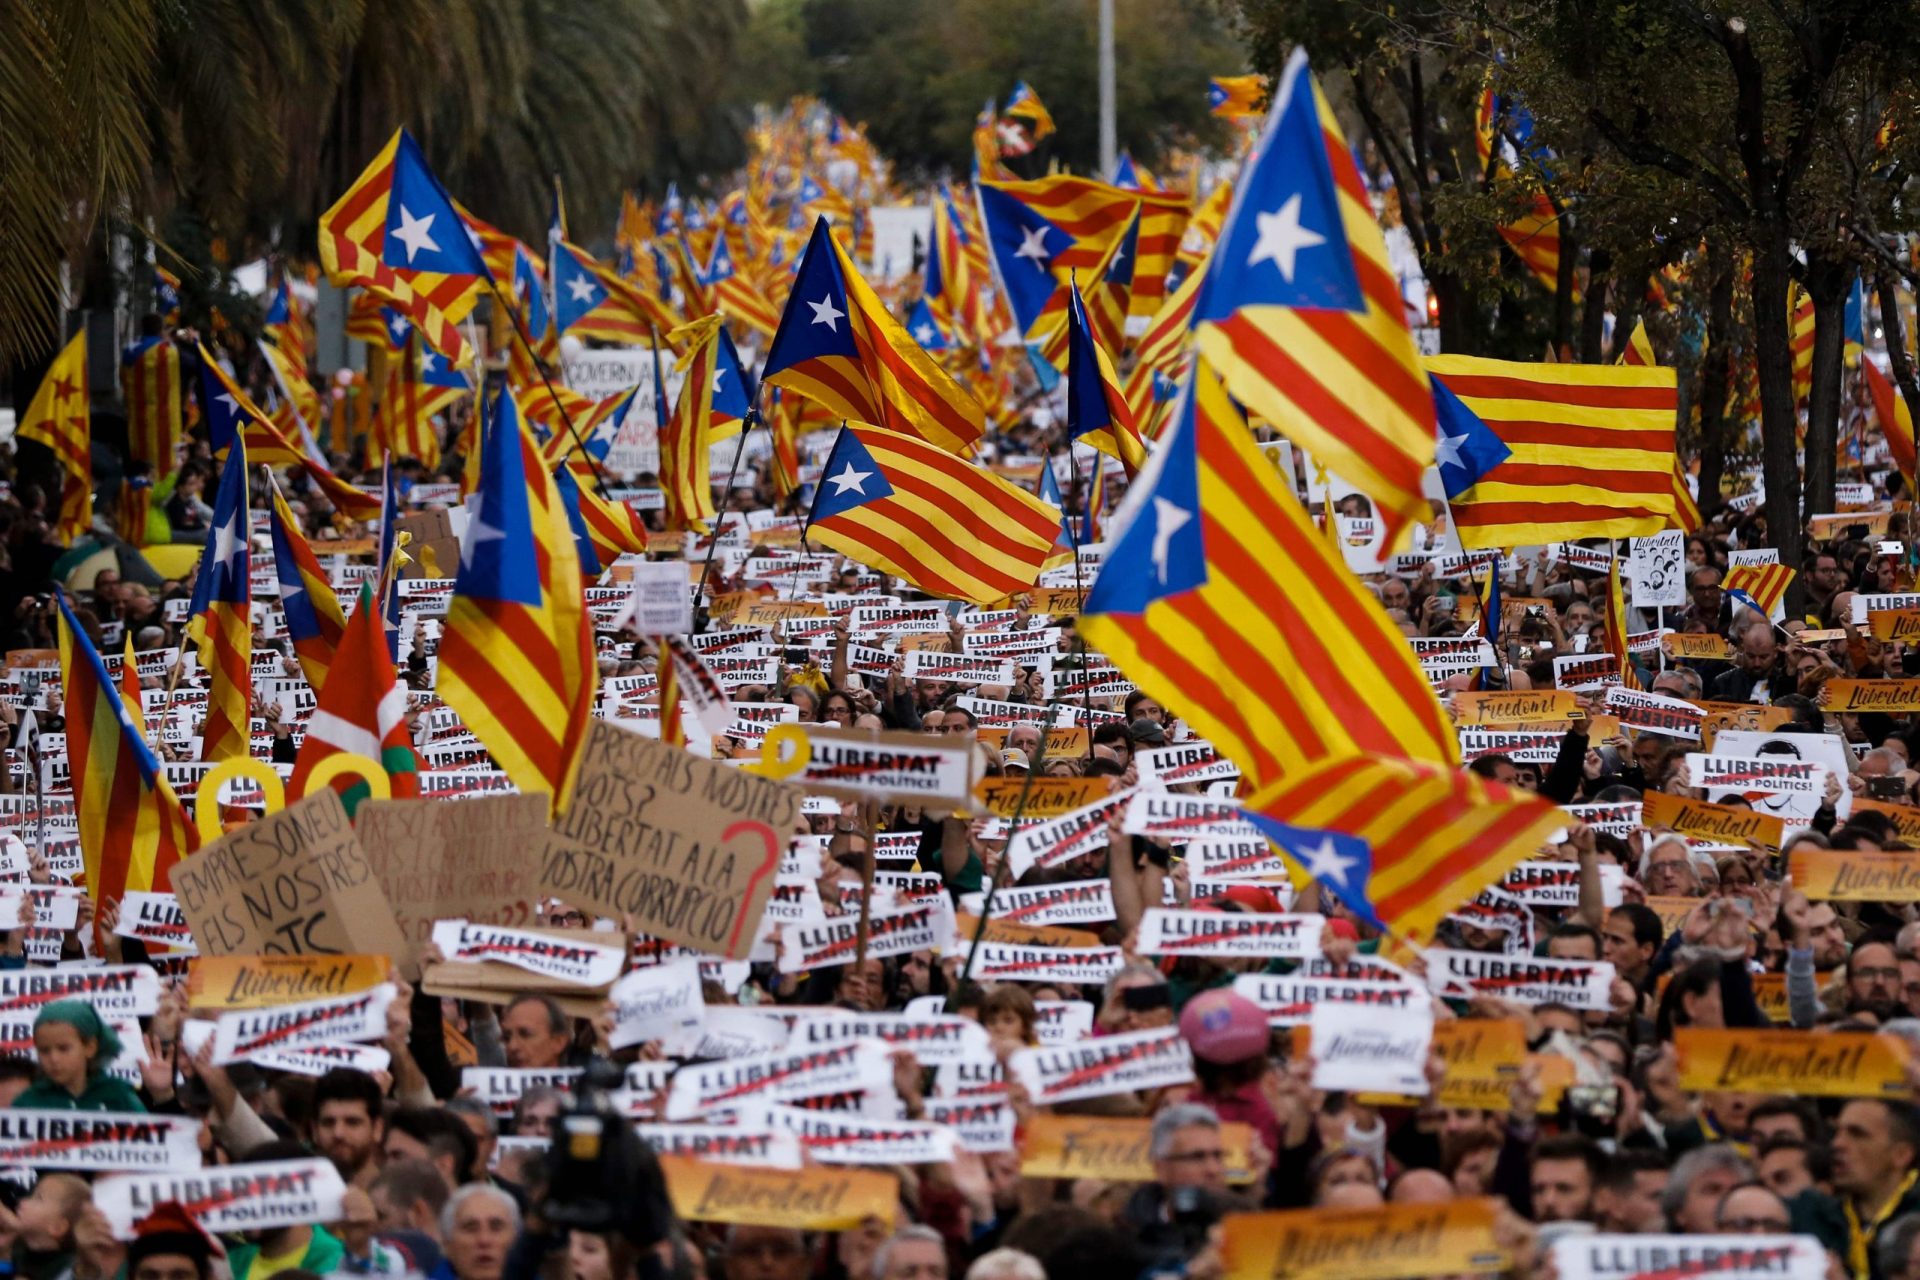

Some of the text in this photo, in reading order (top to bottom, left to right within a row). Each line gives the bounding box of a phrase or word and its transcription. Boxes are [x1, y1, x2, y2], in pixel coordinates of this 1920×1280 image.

[1635, 534, 1680, 550] Llibertat!
[409, 582, 455, 590] LLIBER
[859, 608, 938, 621] LLIBERTAT
[966, 612, 1018, 625] LLIBER
[788, 620, 838, 632] LLIBER
[968, 631, 1047, 645] LLIBERTAT
[706, 659, 767, 671] BERTAT
[855, 648, 894, 664] LLIBE
[918, 655, 1001, 672] LLIBERTAT
[1433, 656, 1481, 664] POLÍTICS!
[721, 673, 767, 681] POLÍTICS!
[956, 672, 1001, 682] POLÍTICS!
[1560, 657, 1618, 677] LLIBER
[615, 678, 655, 691] LLIBE
[1477, 696, 1555, 722] Freedom!
[810, 745, 941, 773] LLIBERTAT
[1154, 747, 1214, 770] LLIBE
[1704, 758, 1811, 780] LLIBERTAT
[656, 750, 693, 794] ALS
[702, 767, 799, 828] NOSTRES
[868, 773, 940, 790] POLÍTICS!
[1755, 779, 1812, 791] POLÍTICS!
[1149, 801, 1235, 819] LLIBER
[1672, 805, 1761, 838] Llibertat!
[553, 803, 681, 868] LLIBERTAT
[179, 794, 342, 913] EMPRESONEU
[1202, 842, 1267, 861] LLIBE
[241, 841, 370, 930] NOSTRES
[1045, 905, 1109, 918] POLÍTICS!
[1161, 917, 1301, 936] LLIBERTAT
[460, 927, 598, 965] LLIBERTAT
[984, 948, 1117, 966] LLIBERTAT
[1450, 956, 1592, 987] LLIBERTAT
[2, 971, 138, 997] LIBERTAT
[226, 962, 354, 1004] Llibertat!
[1260, 982, 1413, 1007] LLIBERTAT
[236, 996, 373, 1039] LLIBERTAT
[808, 1023, 965, 1043] LLIBERTAT
[701, 1045, 858, 1090] LLIBERTAT
[1037, 1038, 1183, 1077] LLIBERTAT
[0, 1117, 173, 1144] LLIBERTAT
[79, 1147, 171, 1163] POLÍTICS!
[652, 1134, 772, 1156] BERTAT
[130, 1169, 317, 1208] LLIBERTAT
[1590, 1245, 1794, 1273] LLIBERTAT
